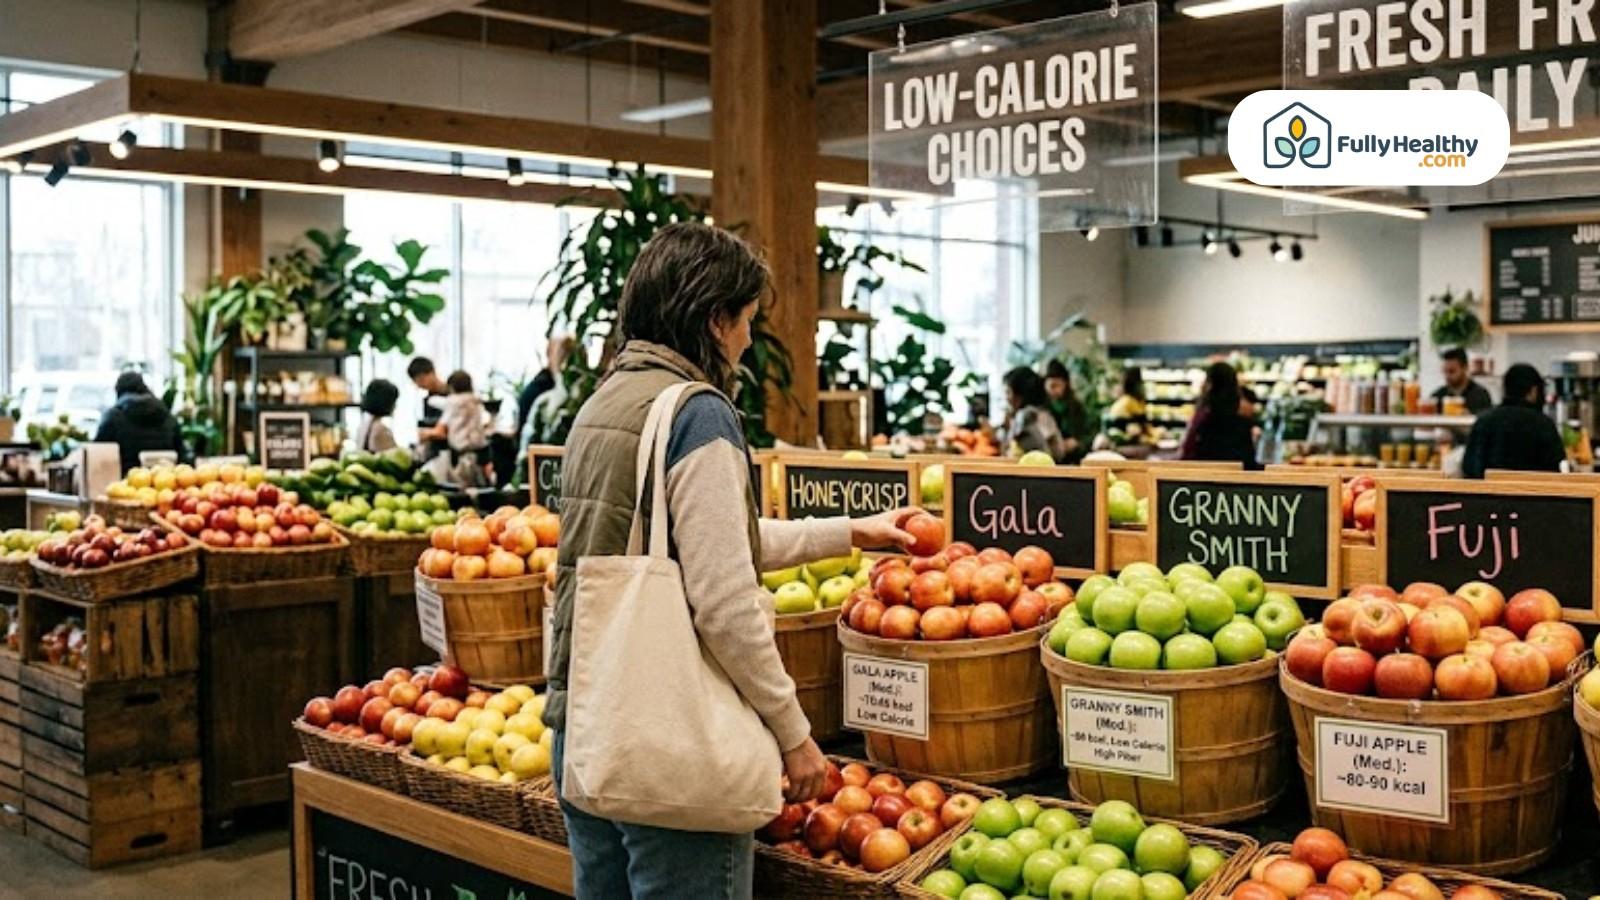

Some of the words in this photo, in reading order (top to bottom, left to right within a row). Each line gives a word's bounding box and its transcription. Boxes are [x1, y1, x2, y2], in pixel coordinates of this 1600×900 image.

[1305, 0, 1486, 77] FRESH
[884, 43, 1138, 131] LOW-CALORIE
[1409, 57, 1589, 133] ILY
[927, 117, 1087, 186] CHOICES
[790, 473, 907, 514] HONEYCRISP
[968, 484, 1064, 540] Gala
[1169, 486, 1302, 538] GRANNY
[1188, 531, 1289, 574] SMITH
[1427, 502, 1520, 580] Fuji
[852, 663, 881, 678] GALA
[883, 668, 919, 684] APPLE
[857, 707, 878, 721] Low
[1070, 698, 1122, 714] GRANNY
[1124, 704, 1164, 720] SMITH
[1334, 731, 1368, 749] FUJI
[1372, 735, 1428, 756] APPLE
[1352, 753, 1408, 775] (Med.):
[1393, 777, 1426, 796] kcal
